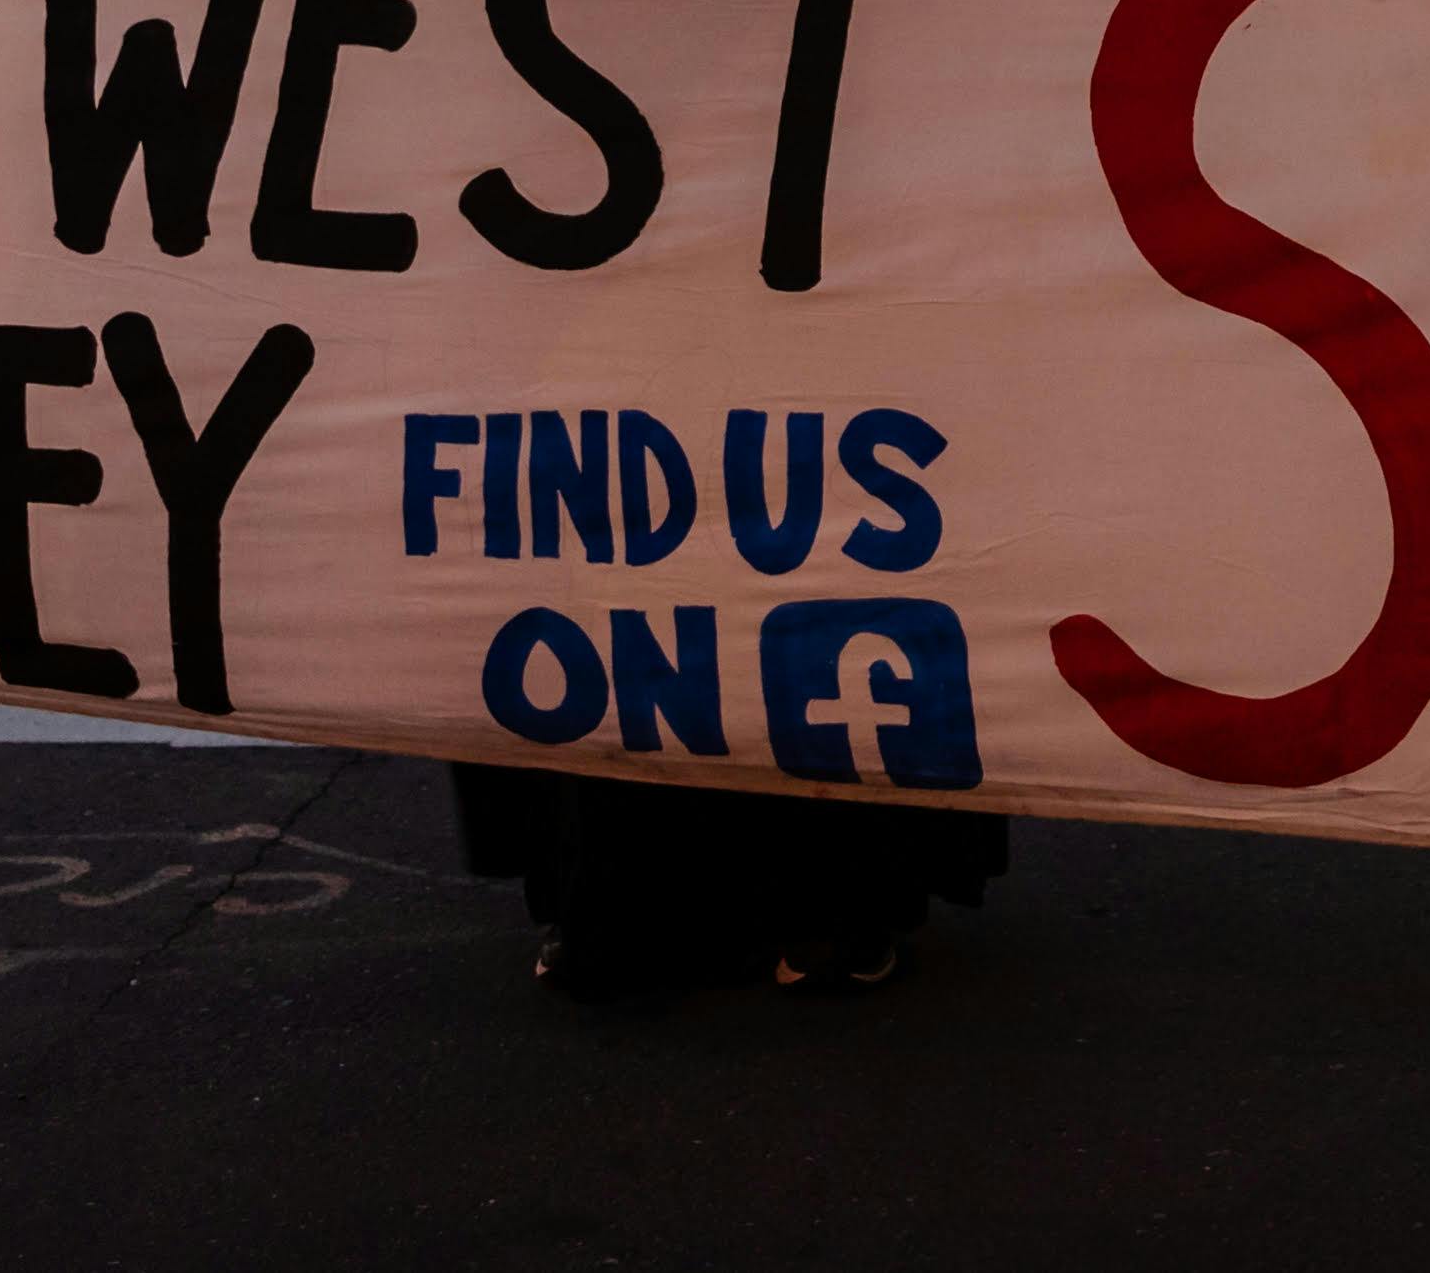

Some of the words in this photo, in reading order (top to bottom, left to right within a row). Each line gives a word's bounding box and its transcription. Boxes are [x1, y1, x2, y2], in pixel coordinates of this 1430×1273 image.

[402, 409, 698, 567] FIND
[722, 407, 949, 576] US
[481, 605, 730, 756] ON
